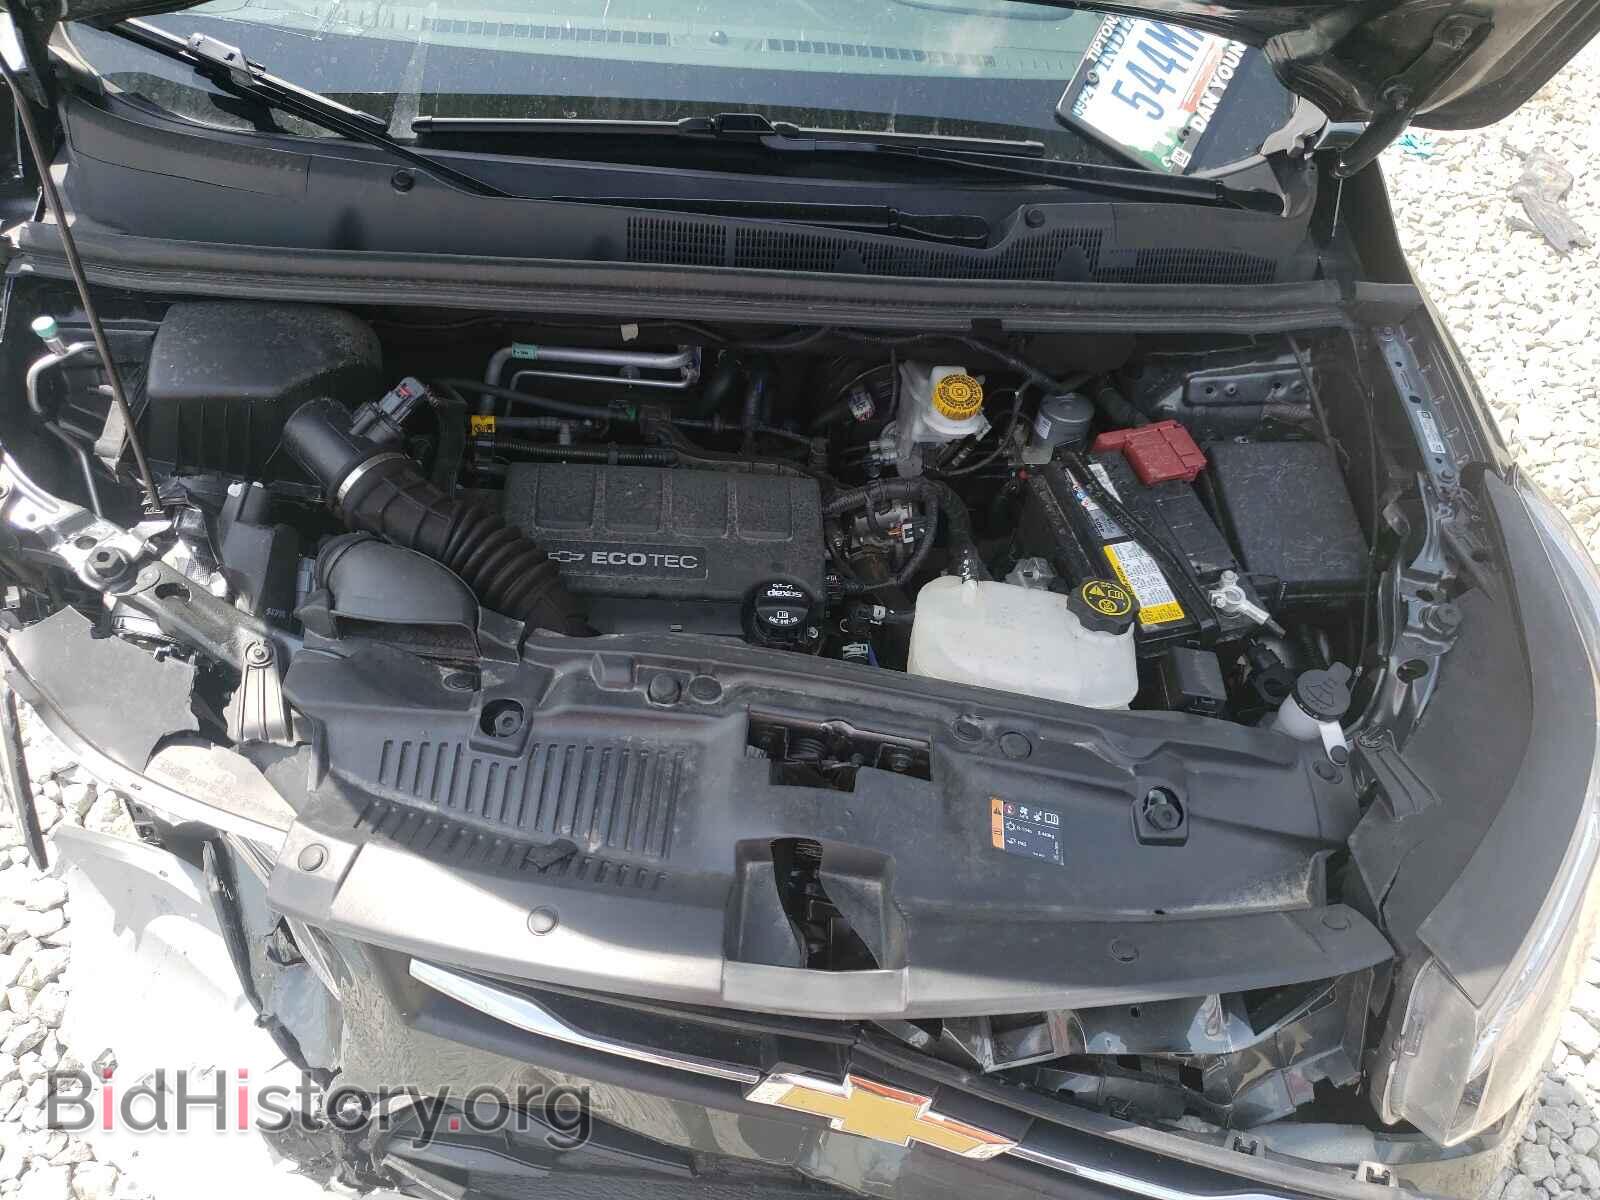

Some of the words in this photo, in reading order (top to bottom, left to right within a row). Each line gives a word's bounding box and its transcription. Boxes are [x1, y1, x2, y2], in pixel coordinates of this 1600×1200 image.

[1188, 91, 1221, 134] DAN
[591, 551, 699, 569] ECOTEC
[767, 588, 802, 598] dexos
